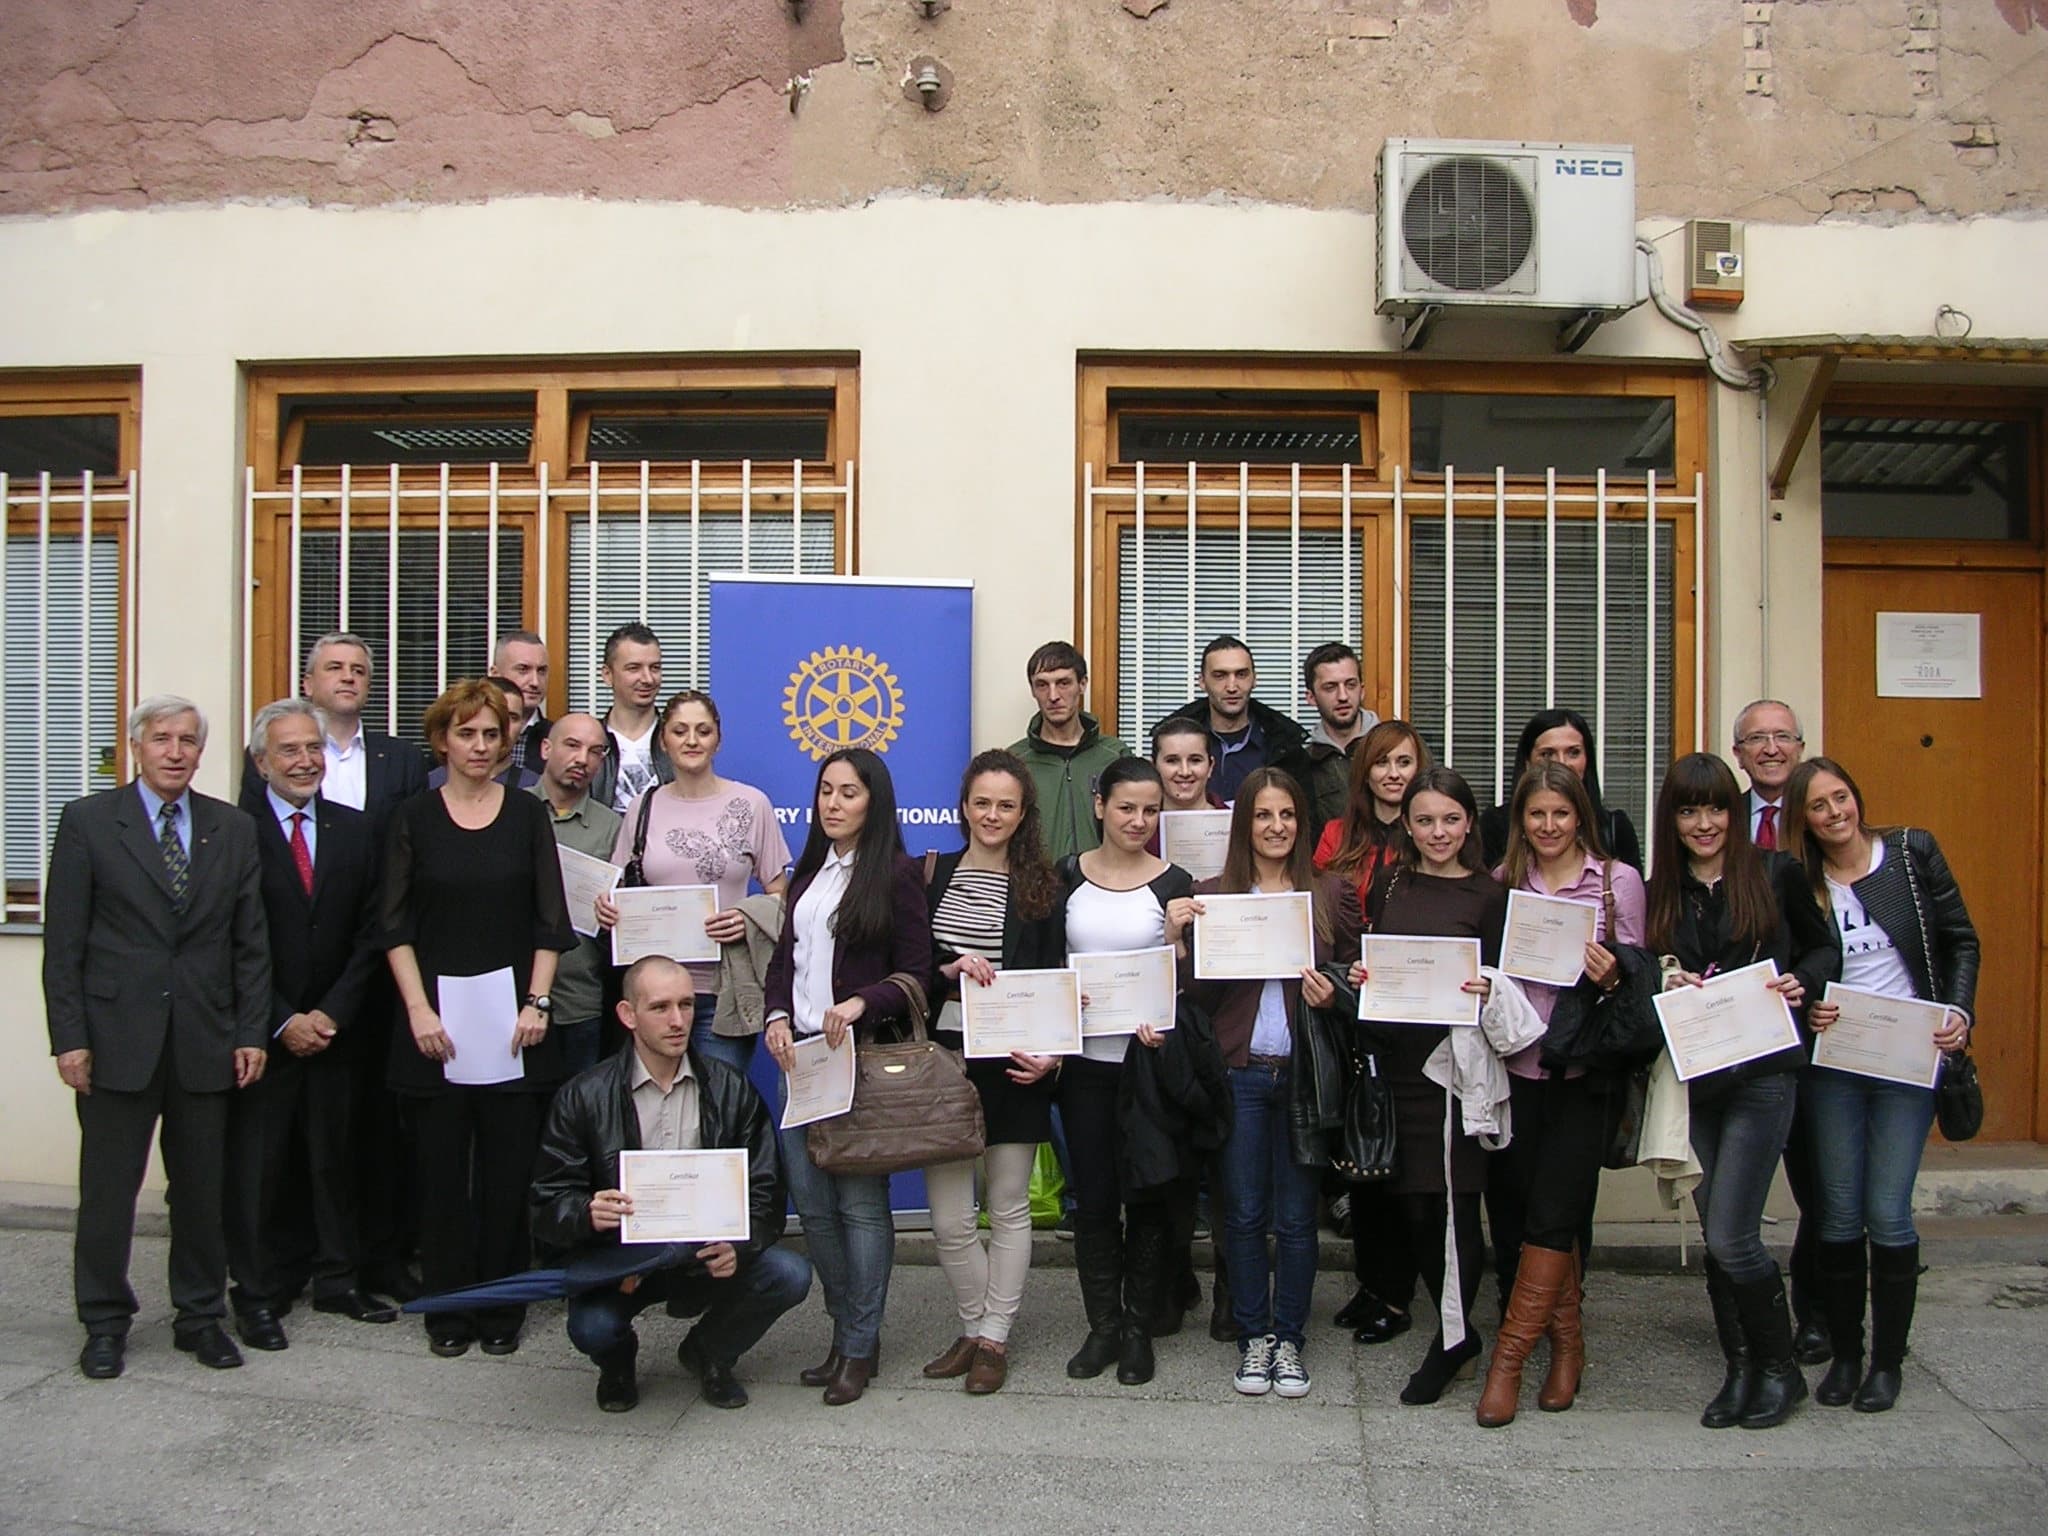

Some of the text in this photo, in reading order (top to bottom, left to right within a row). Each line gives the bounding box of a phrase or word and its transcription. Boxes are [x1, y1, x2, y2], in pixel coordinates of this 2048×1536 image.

[1556, 160, 1622, 176] NEO
[820, 659, 869, 673] ROTARY
[1848, 940, 1894, 954] ARIS
[1706, 996, 1734, 1010] Certifikat
[669, 1172, 699, 1180] Certifikat
